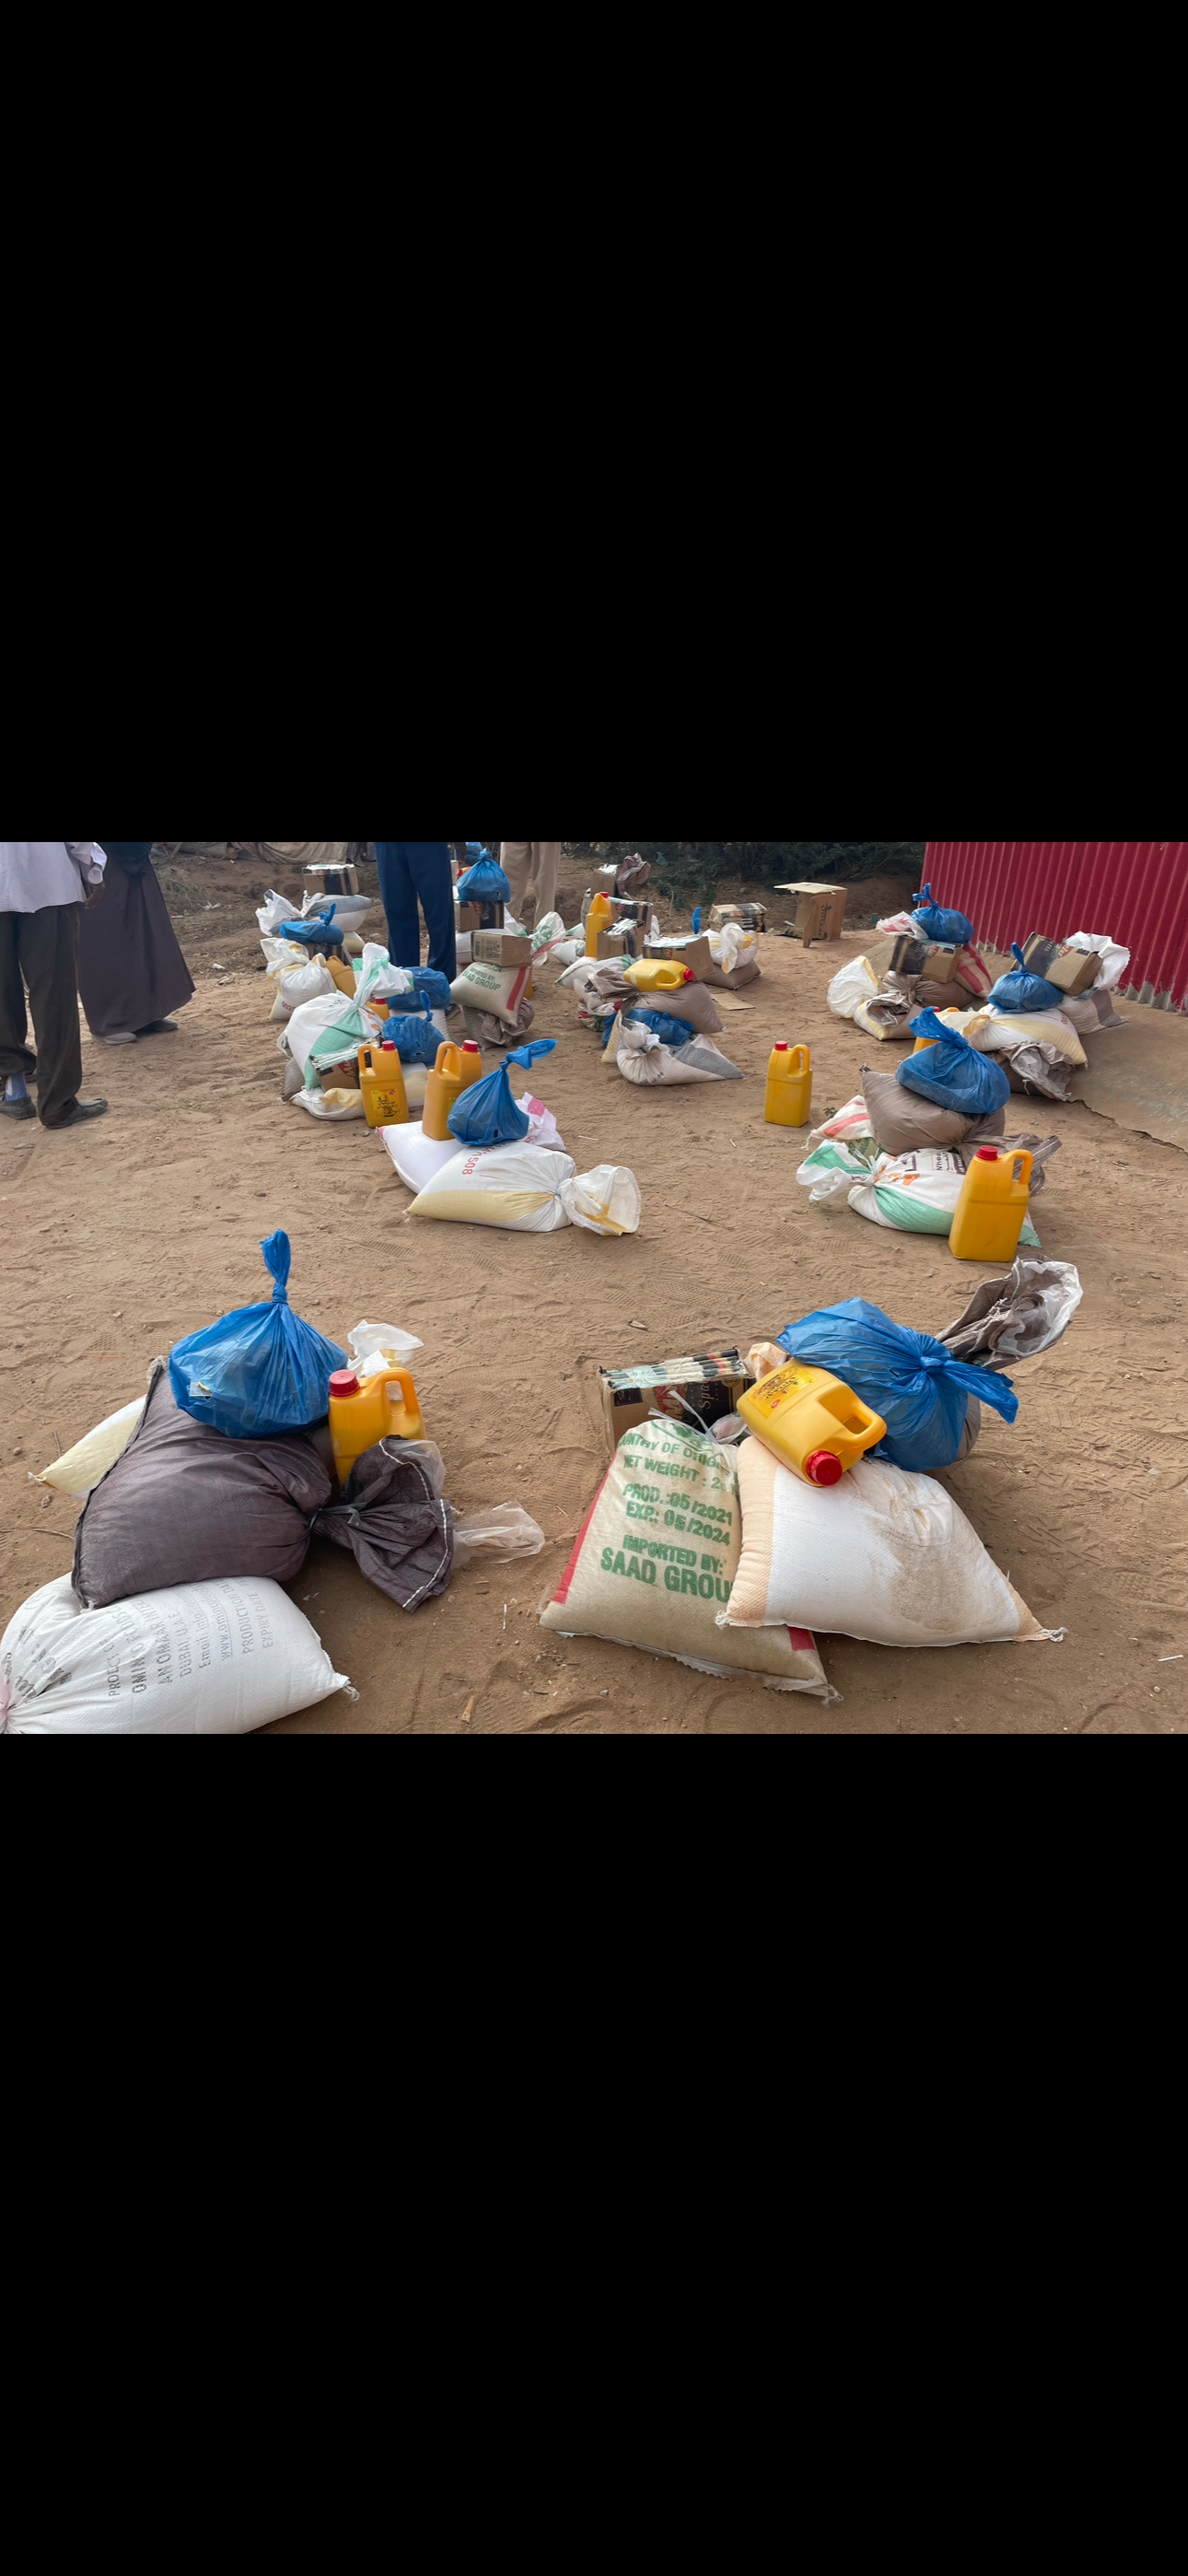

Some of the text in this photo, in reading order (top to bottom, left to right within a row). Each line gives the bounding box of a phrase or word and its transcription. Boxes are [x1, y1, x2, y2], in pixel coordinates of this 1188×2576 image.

[475, 977, 501, 990] GROUP
[662, 1442, 681, 1454] OF
[645, 1458, 700, 1481] WEIGHT
[623, 1535, 723, 1575] IMPORTED BY:
[600, 1547, 733, 1603] SAAD GROU
[228, 1592, 254, 1655] PRODUCTION
[257, 1611, 274, 1648] EXPIRY
